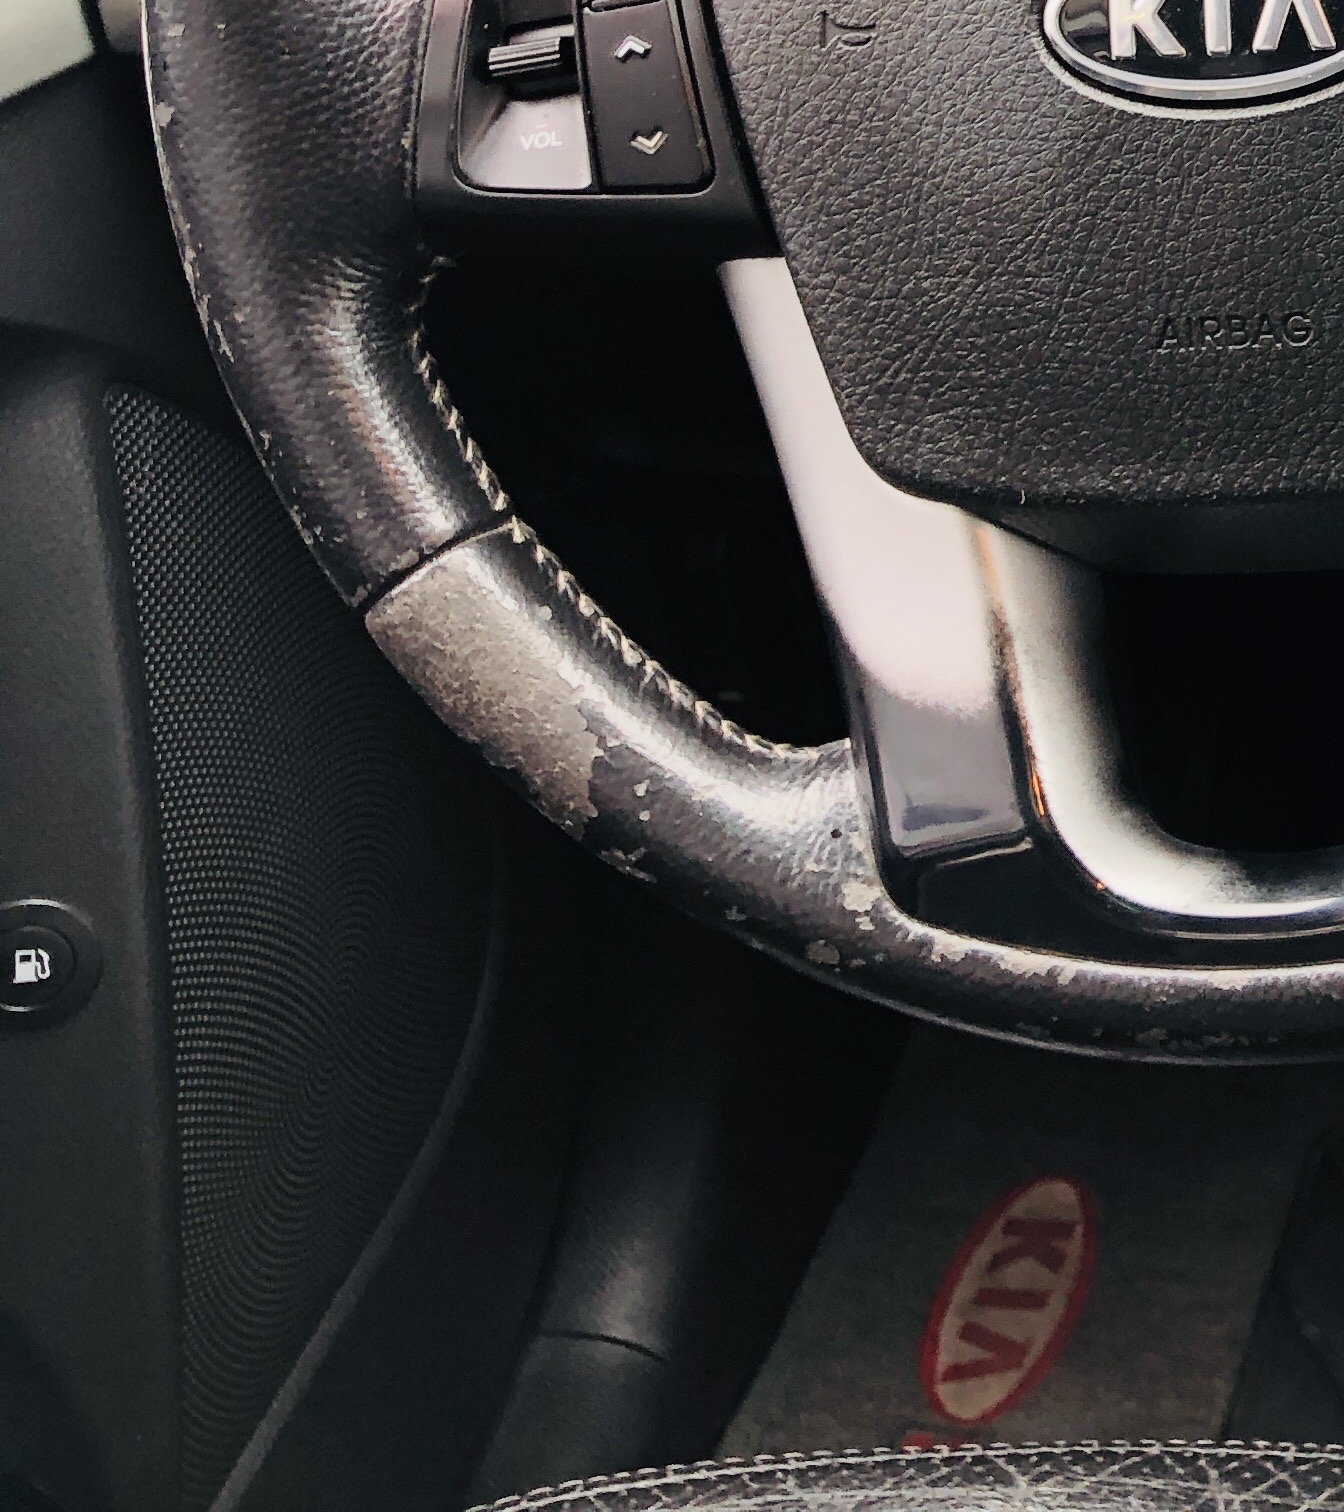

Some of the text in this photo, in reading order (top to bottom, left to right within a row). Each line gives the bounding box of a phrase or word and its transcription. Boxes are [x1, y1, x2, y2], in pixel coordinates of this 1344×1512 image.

[519, 130, 563, 151] VOL
[1156, 313, 1315, 354] AIRBAG
[940, 1217, 1078, 1382] KIA
